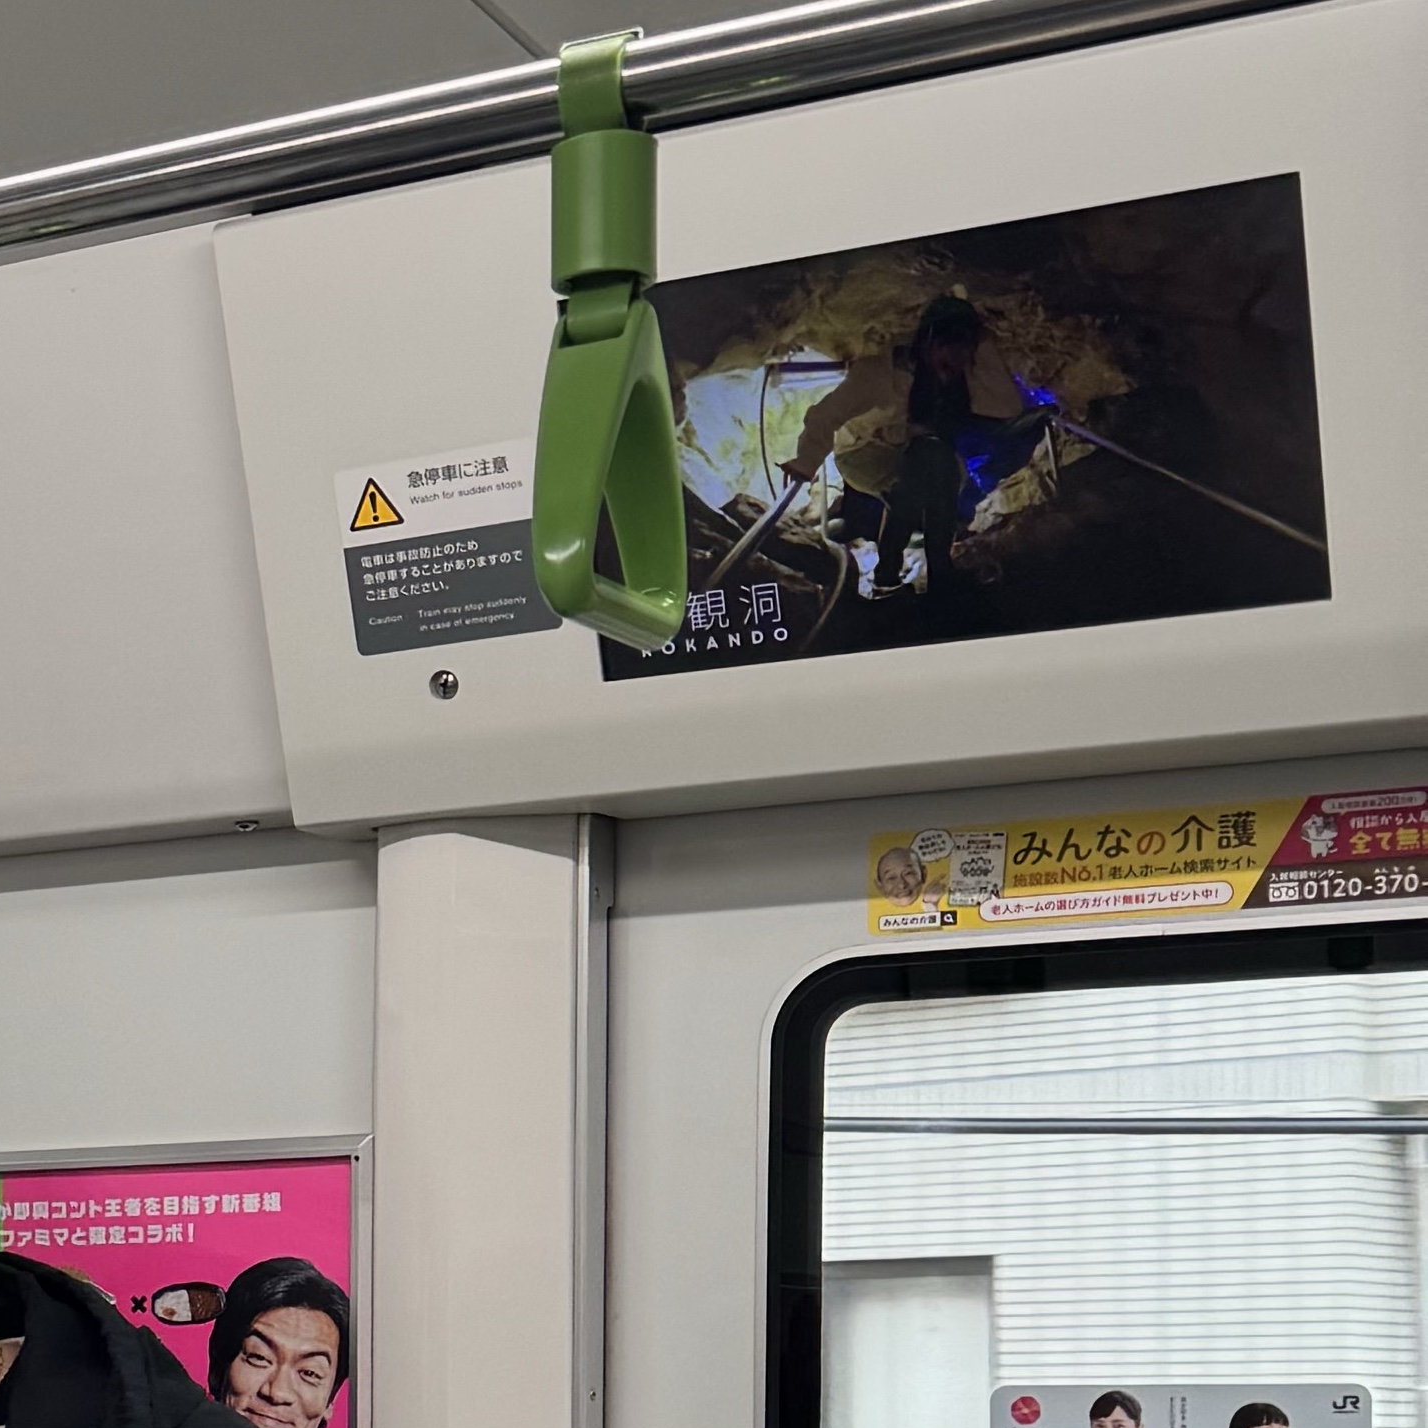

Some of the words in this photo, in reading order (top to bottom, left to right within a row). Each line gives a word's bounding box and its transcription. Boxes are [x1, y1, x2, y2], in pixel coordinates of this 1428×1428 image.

[407, 456, 509, 489] 急停車に注意
[409, 489, 440, 505] Watch
[442, 488, 455, 500] for
[458, 484, 493, 497] sudden
[496, 479, 523, 492] stops
[360, 540, 478, 568] 電車は事故防止のため
[363, 550, 523, 585] 急停車することがありますので
[365, 581, 450, 601] ご注意ください。
[368, 613, 403, 626] Caution
[1013, 811, 1257, 866] みんなの介護
[1349, 827, 1428, 855] 全て無
[1108, 855, 1257, 880] 老人ホーム検索サイト
[1332, 1395, 1360, 1410] JR
